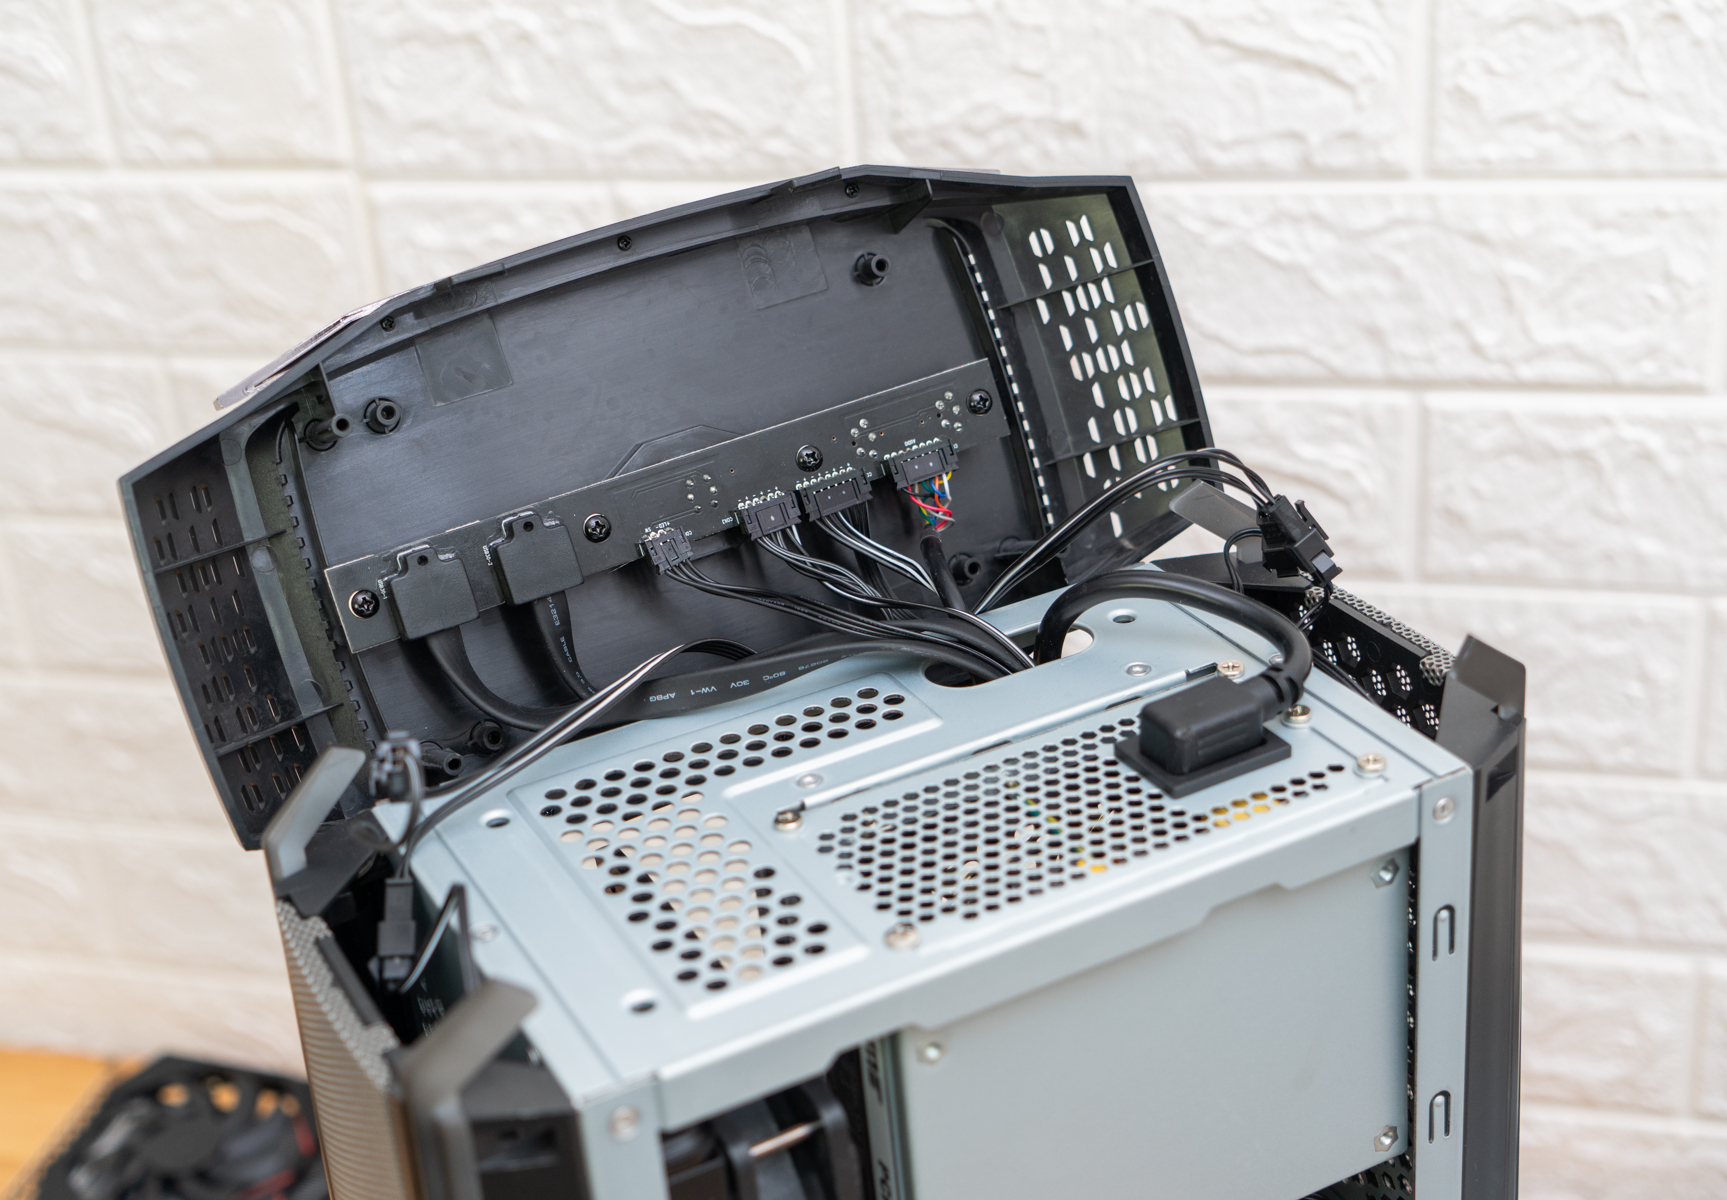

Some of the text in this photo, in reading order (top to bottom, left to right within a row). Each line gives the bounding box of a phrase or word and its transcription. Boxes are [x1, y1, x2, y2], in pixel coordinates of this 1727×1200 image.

[559, 636, 573, 663] CABLE
[729, 679, 750, 689] 30V
[690, 685, 718, 696] VW-1
[648, 692, 676, 703] APBG
